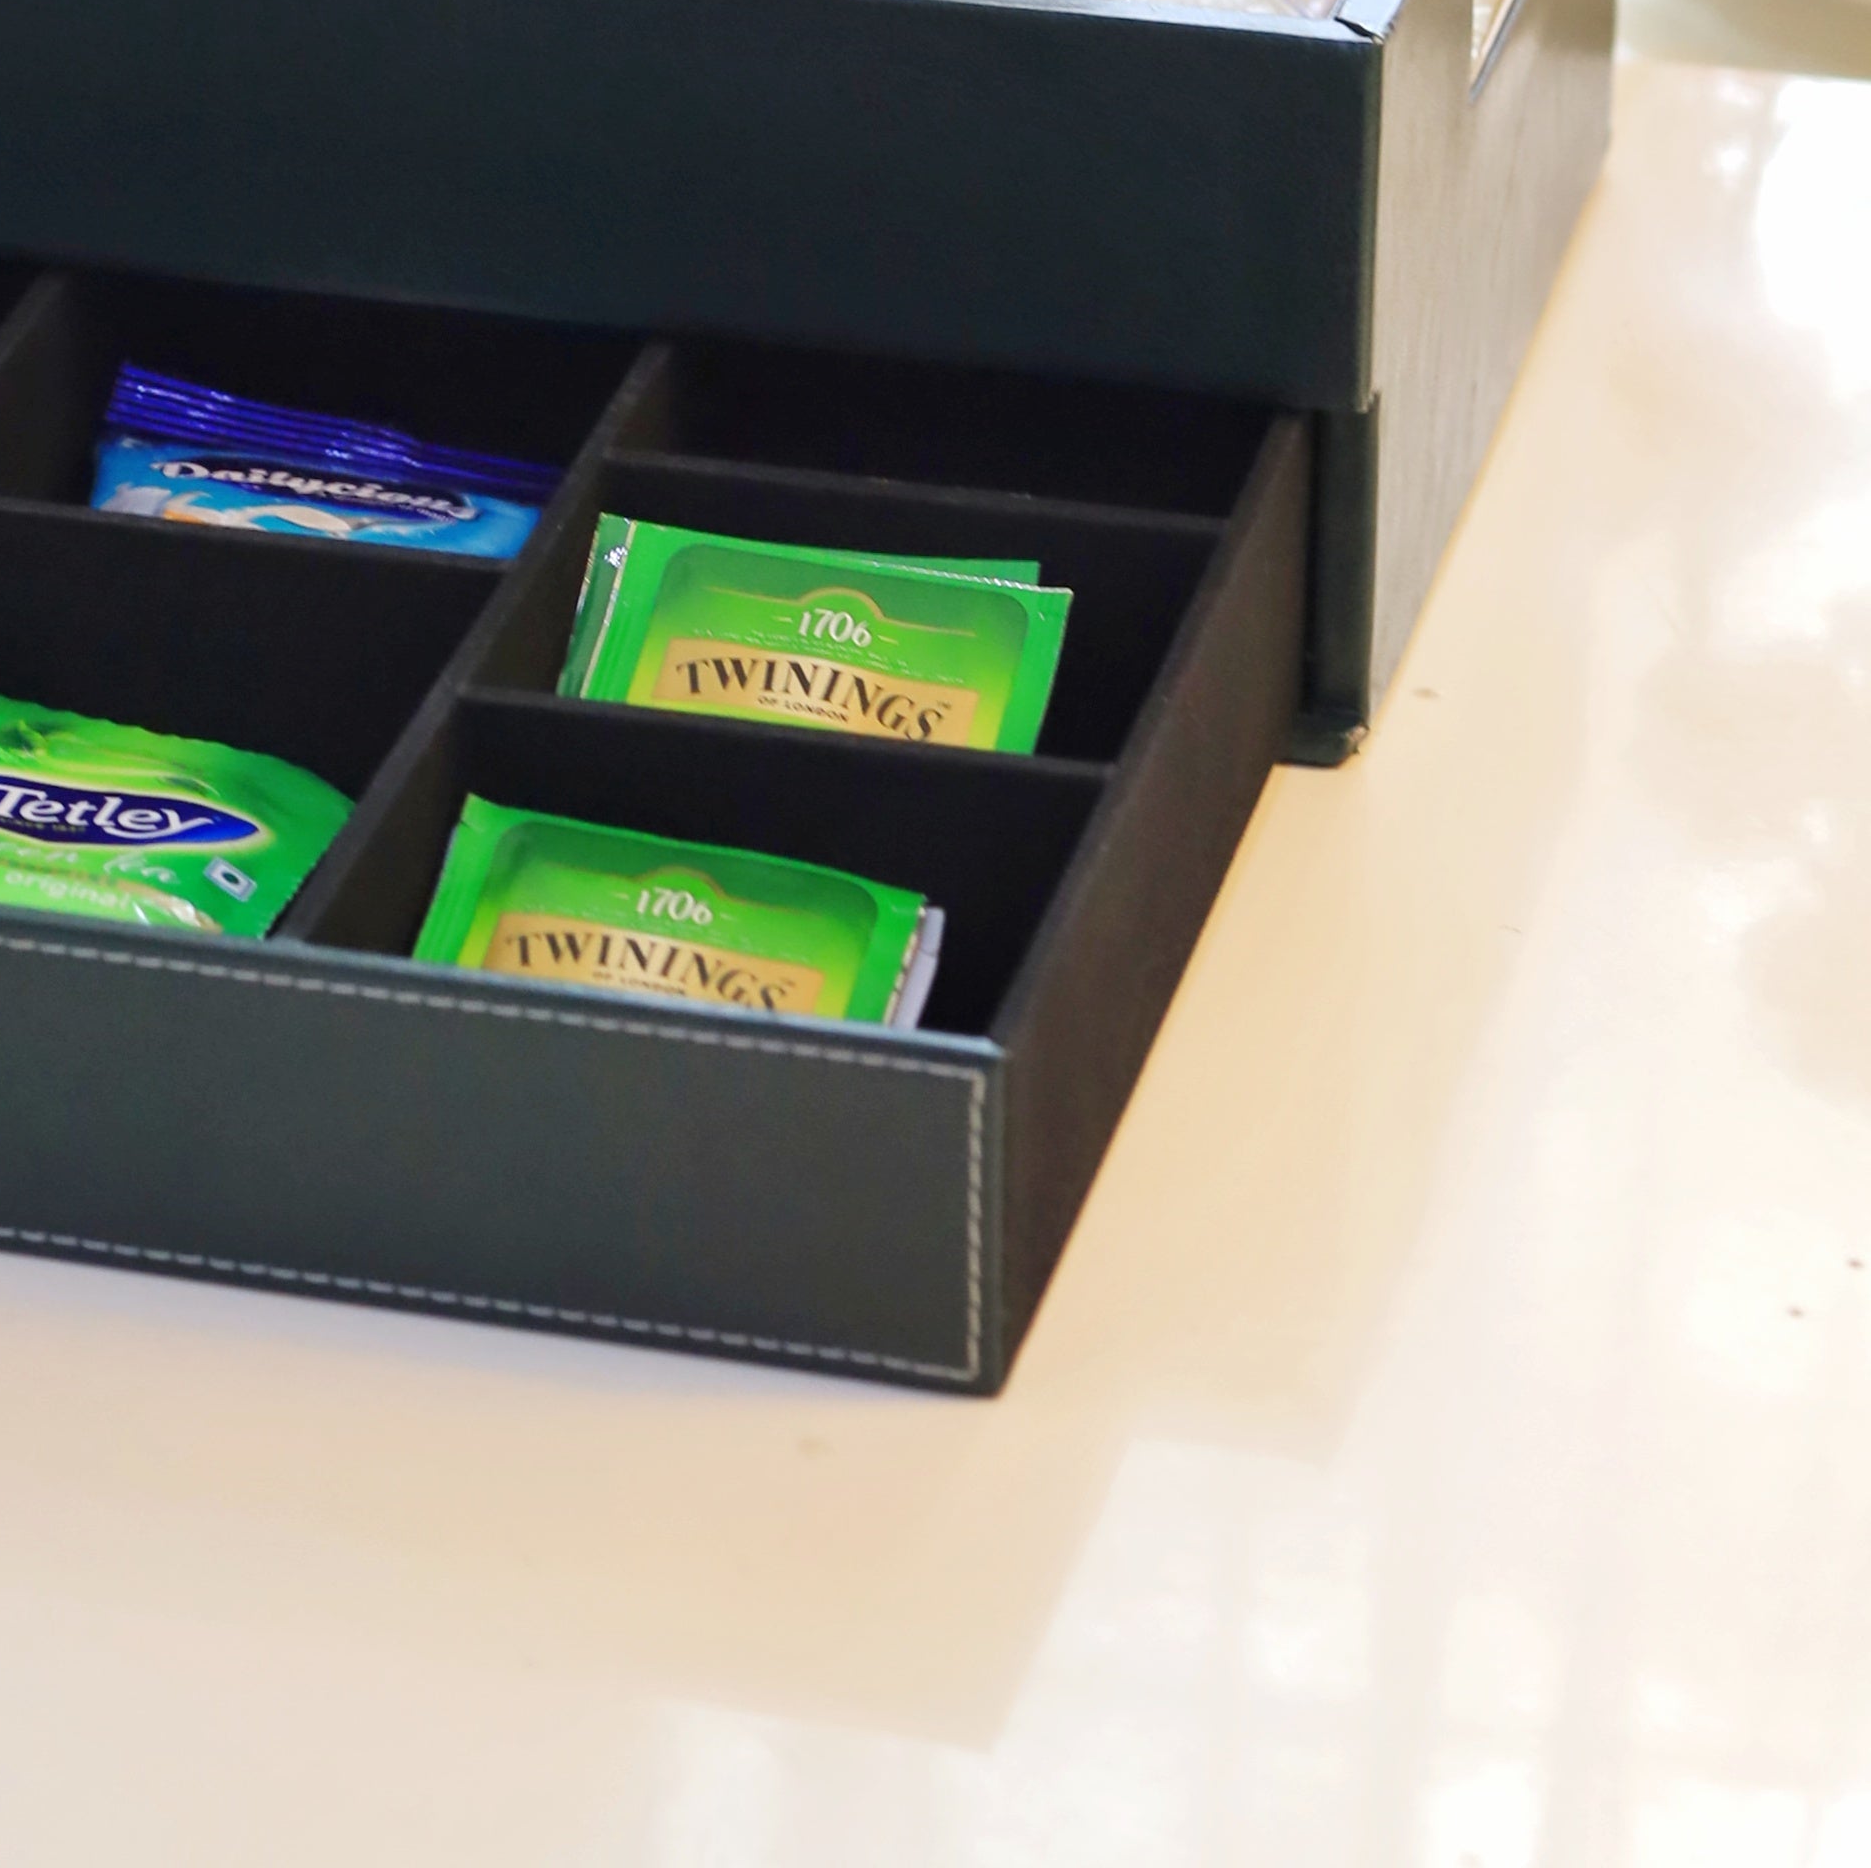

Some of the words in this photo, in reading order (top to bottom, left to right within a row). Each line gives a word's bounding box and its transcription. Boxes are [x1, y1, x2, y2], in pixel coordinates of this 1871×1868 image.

[798, 607, 872, 648] 1706
[676, 657, 944, 742] TWININGS
[636, 887, 713, 926] 1706
